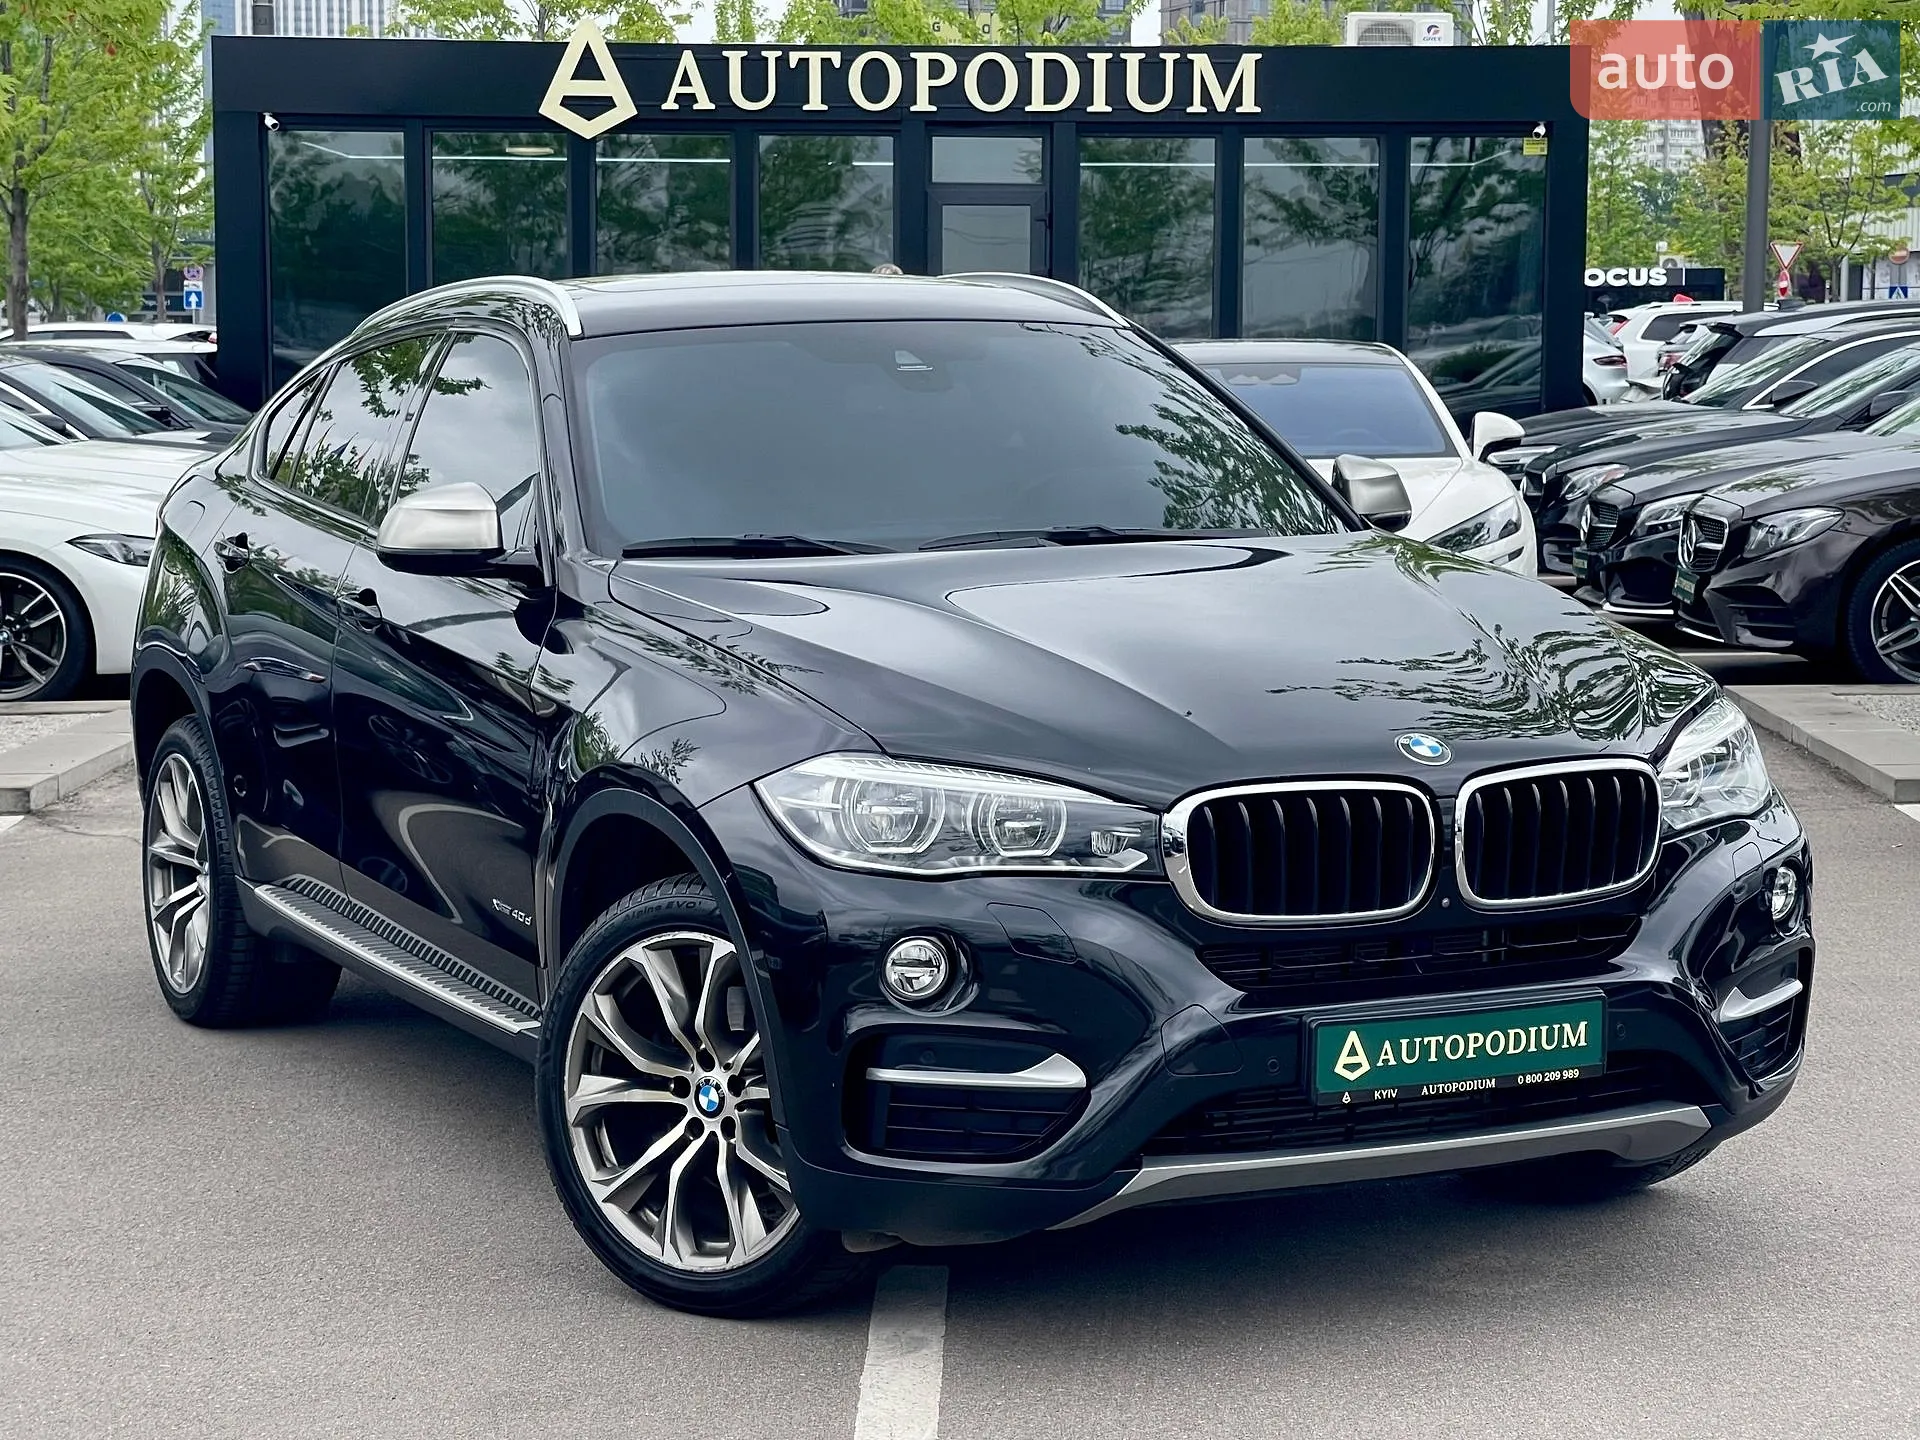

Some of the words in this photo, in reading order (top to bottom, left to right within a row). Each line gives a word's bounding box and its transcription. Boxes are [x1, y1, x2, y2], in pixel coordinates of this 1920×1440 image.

[661, 50, 1262, 112] AUTOPODIUM
[1376, 1021, 1588, 1066] AUTOPODIUM
[1374, 1088, 1398, 1100] KYIV
[1421, 1078, 1496, 1096] AUTOPODIUM
[1517, 1075, 1524, 1085] 0
[1525, 1072, 1543, 1084] 800
[1544, 1070, 1561, 1082] 209
[1562, 1068, 1580, 1080] 989
